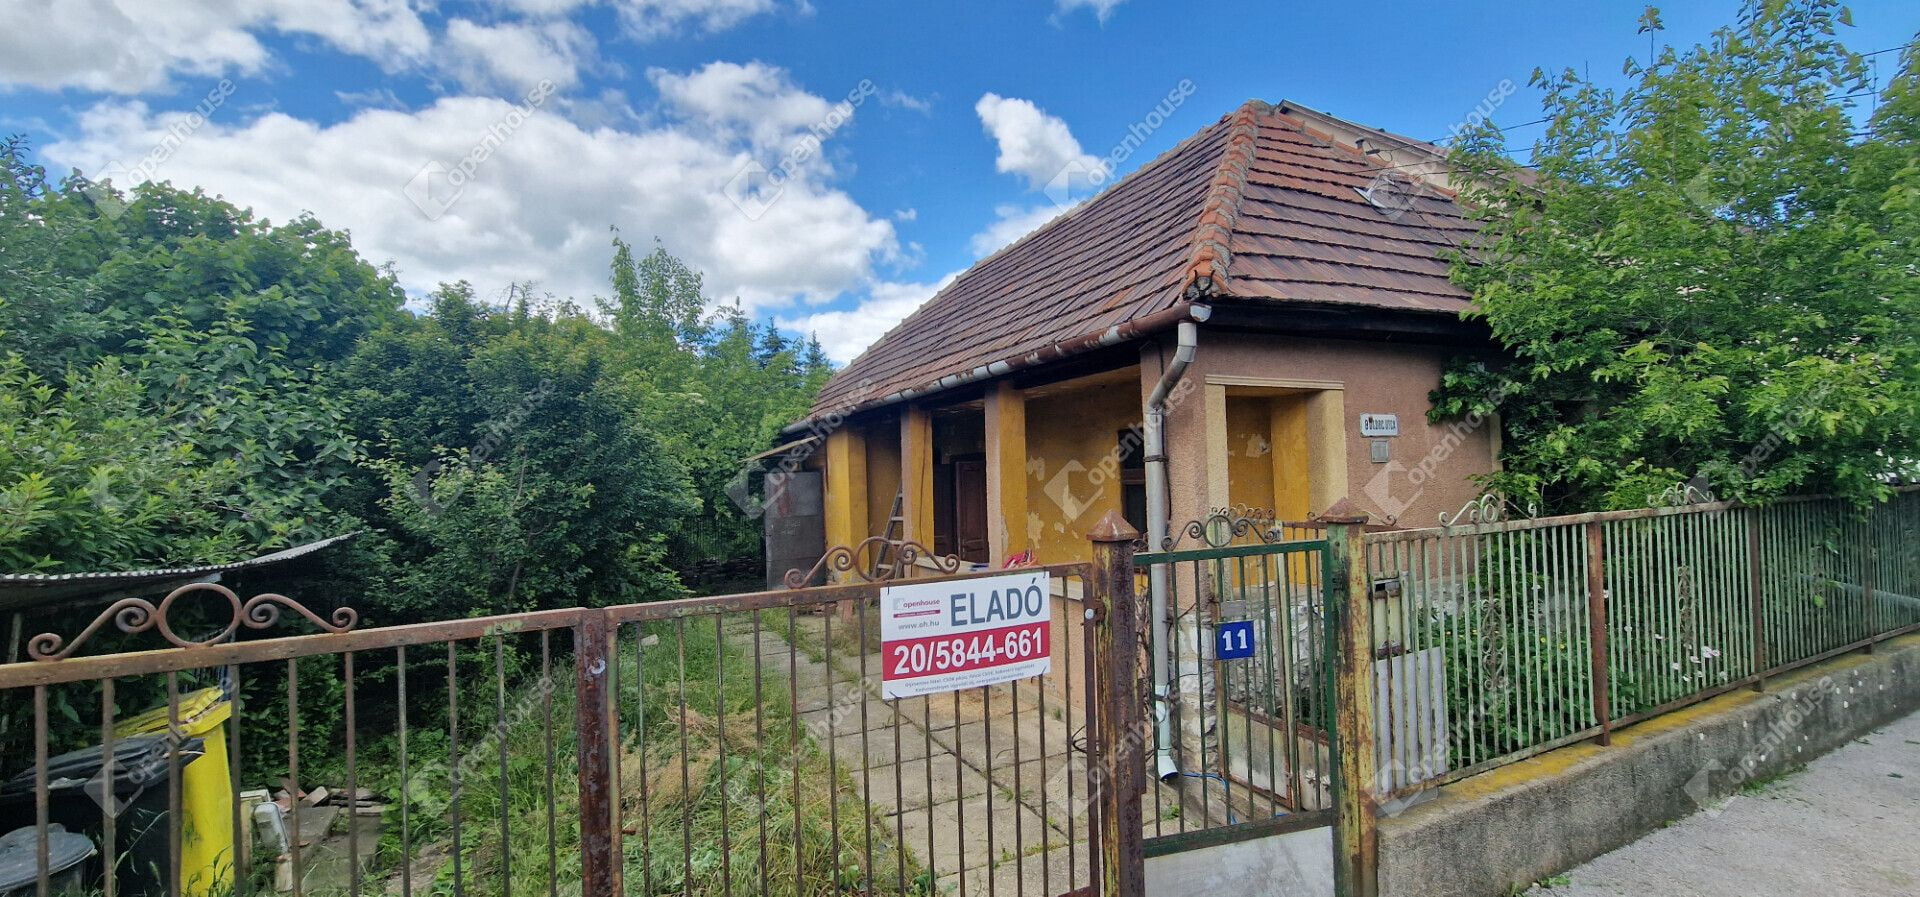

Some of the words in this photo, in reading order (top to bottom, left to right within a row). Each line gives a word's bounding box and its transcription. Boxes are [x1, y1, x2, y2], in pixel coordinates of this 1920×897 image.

[903, 599, 940, 609] openhouse
[950, 577, 1043, 627] ELADÓ
[898, 620, 940, 630] www.oh.hu
[894, 627, 1042, 675] 20/5844-661
[1222, 628, 1248, 651] 11
